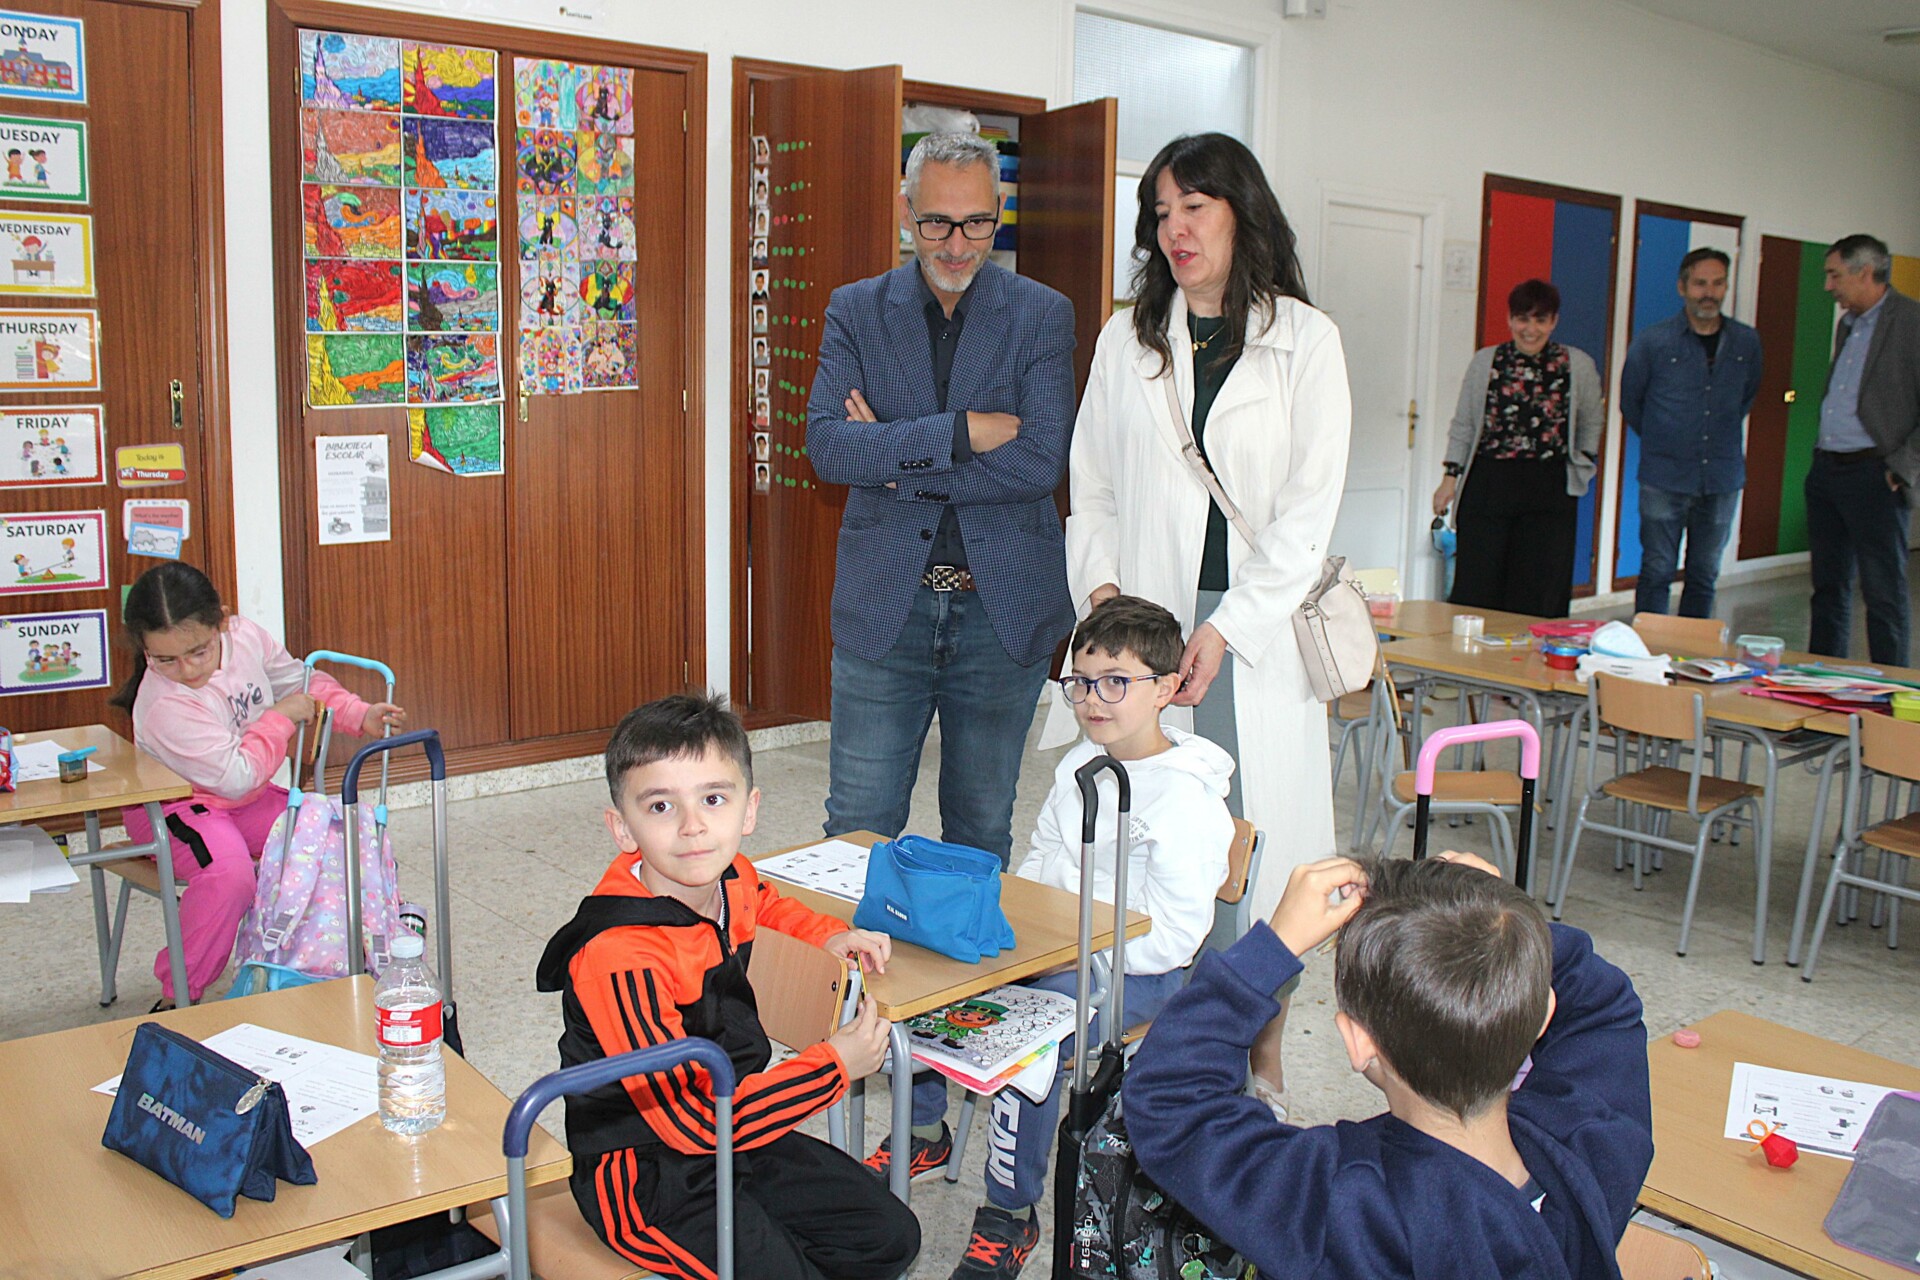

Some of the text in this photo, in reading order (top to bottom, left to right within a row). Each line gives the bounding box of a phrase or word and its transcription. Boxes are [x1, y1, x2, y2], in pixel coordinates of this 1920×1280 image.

[0, 24, 58, 41] ONDAY
[0, 128, 60, 144] UESDAY
[16, 416, 70, 429] FRIDAY
[325, 441, 373, 452] BIBLIOTECA
[325, 450, 365, 460] ESCOLAR
[136, 470, 169, 479] Thursday
[6, 523, 86, 538] SATURDAY
[18, 623, 80, 638] SUNDAY
[137, 1092, 206, 1145] BATMAN
